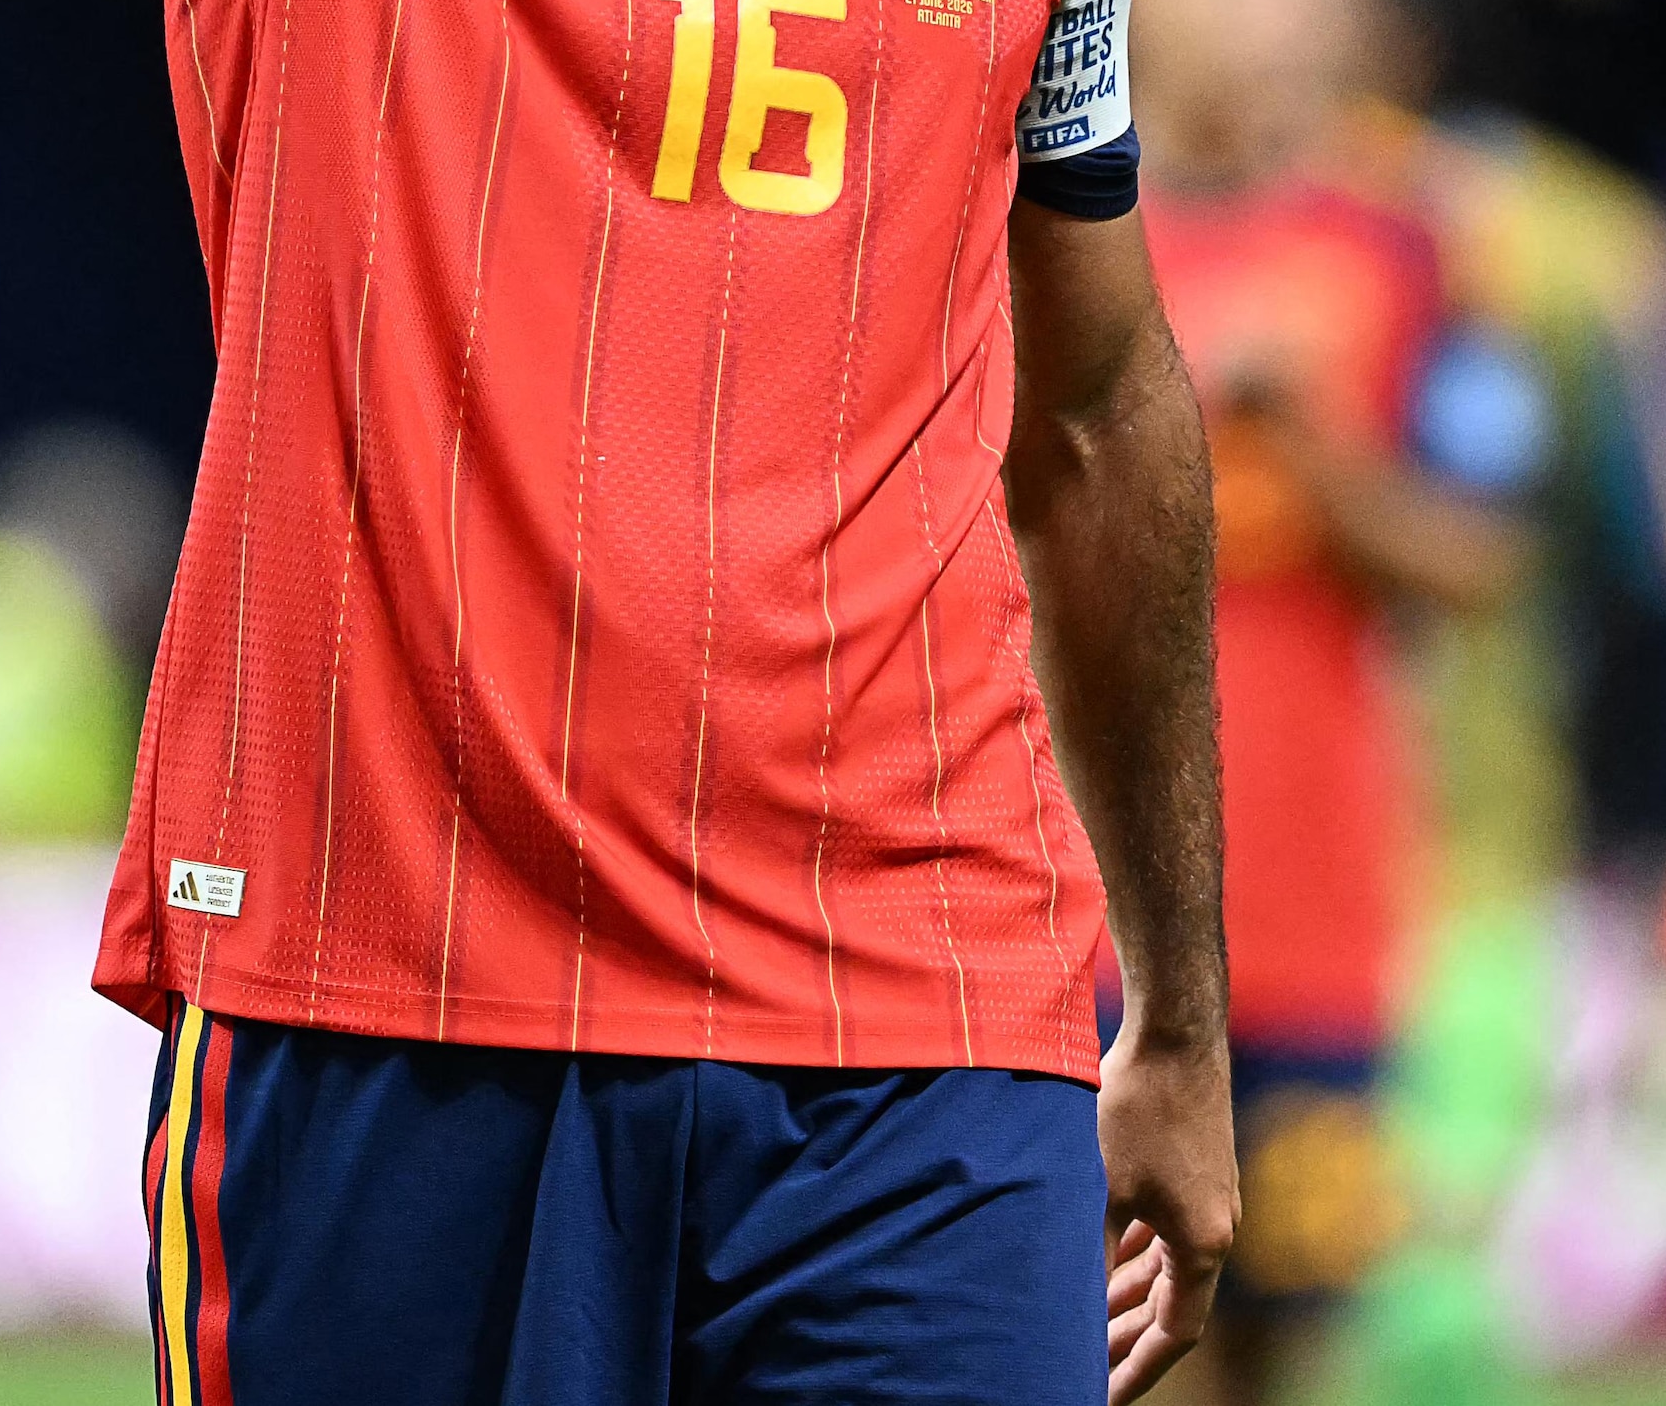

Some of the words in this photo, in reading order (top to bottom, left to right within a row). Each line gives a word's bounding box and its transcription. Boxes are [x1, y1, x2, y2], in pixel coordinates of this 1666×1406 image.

[917, 9, 961, 29] ATLANTA
[1031, 21, 1113, 84] ITES
[1038, 60, 1116, 119] World
[1031, 123, 1086, 148] FIFA
